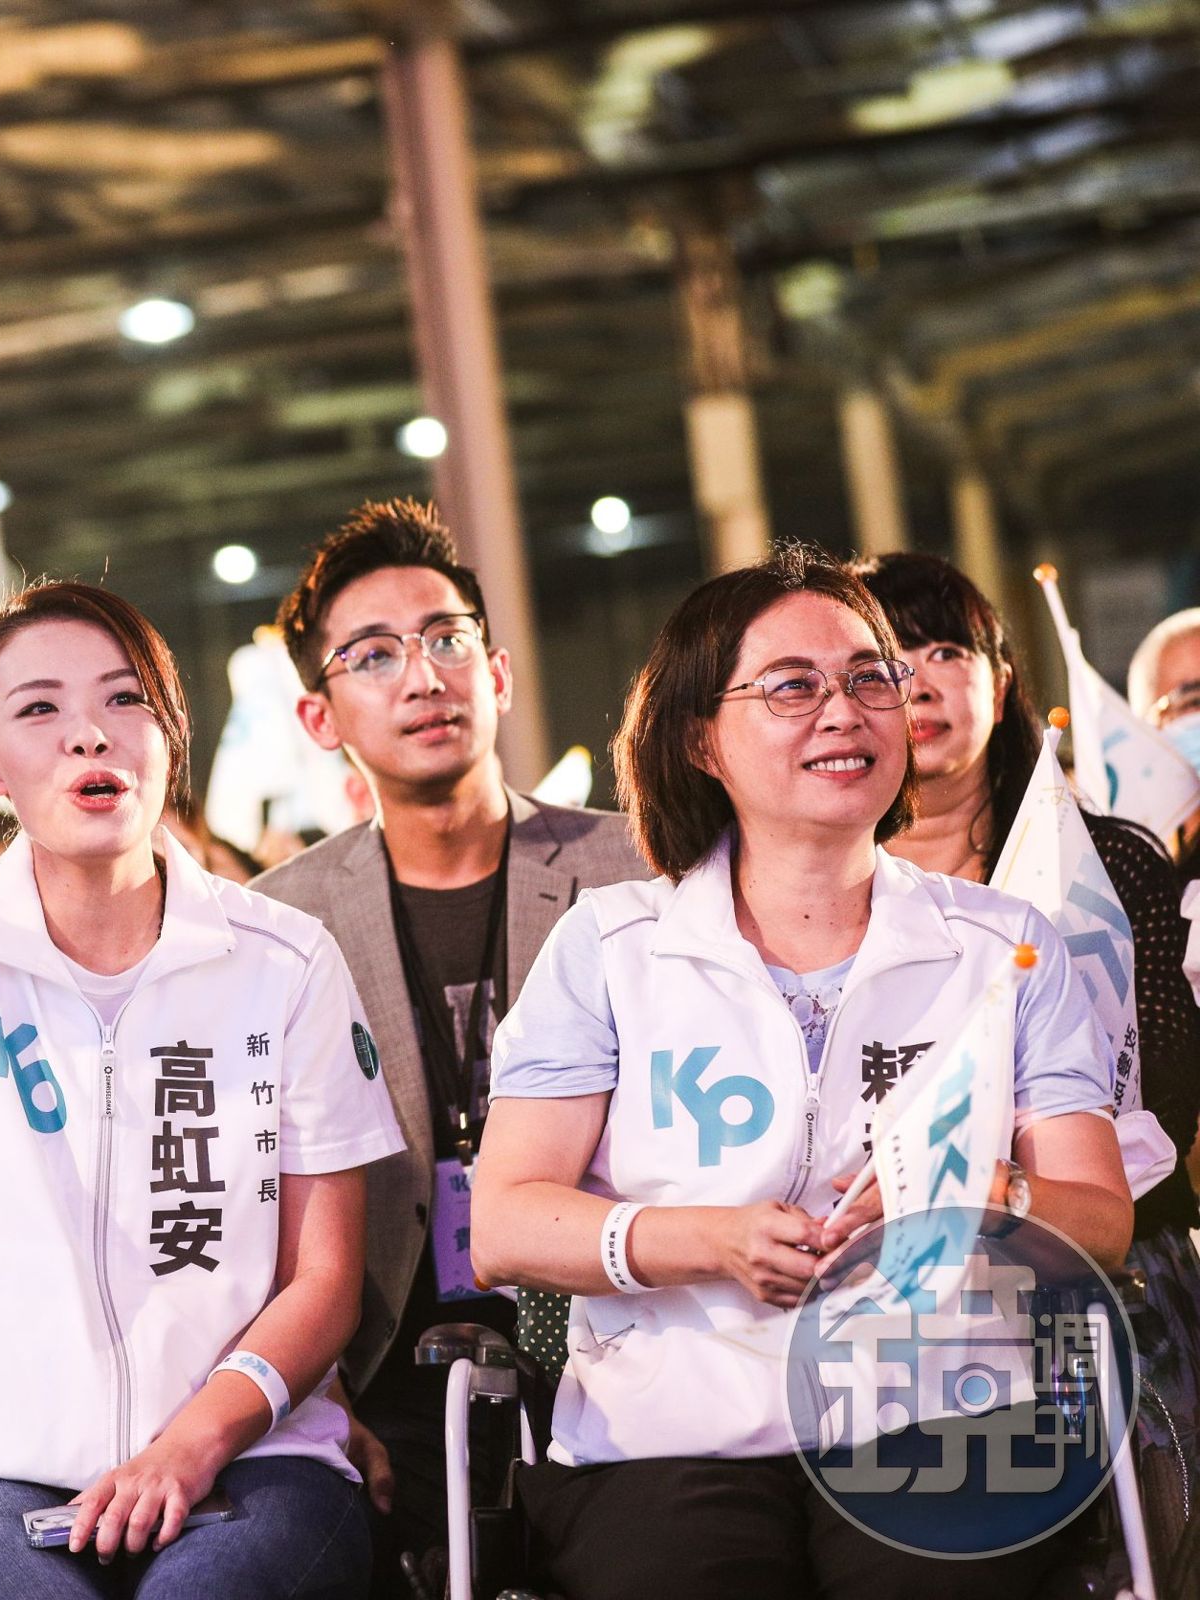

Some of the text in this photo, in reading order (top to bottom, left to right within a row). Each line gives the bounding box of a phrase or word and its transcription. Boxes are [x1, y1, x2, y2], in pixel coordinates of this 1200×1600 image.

[149, 1039, 227, 1277] 高虹安
[246, 1032, 278, 1204] 新竹市長
